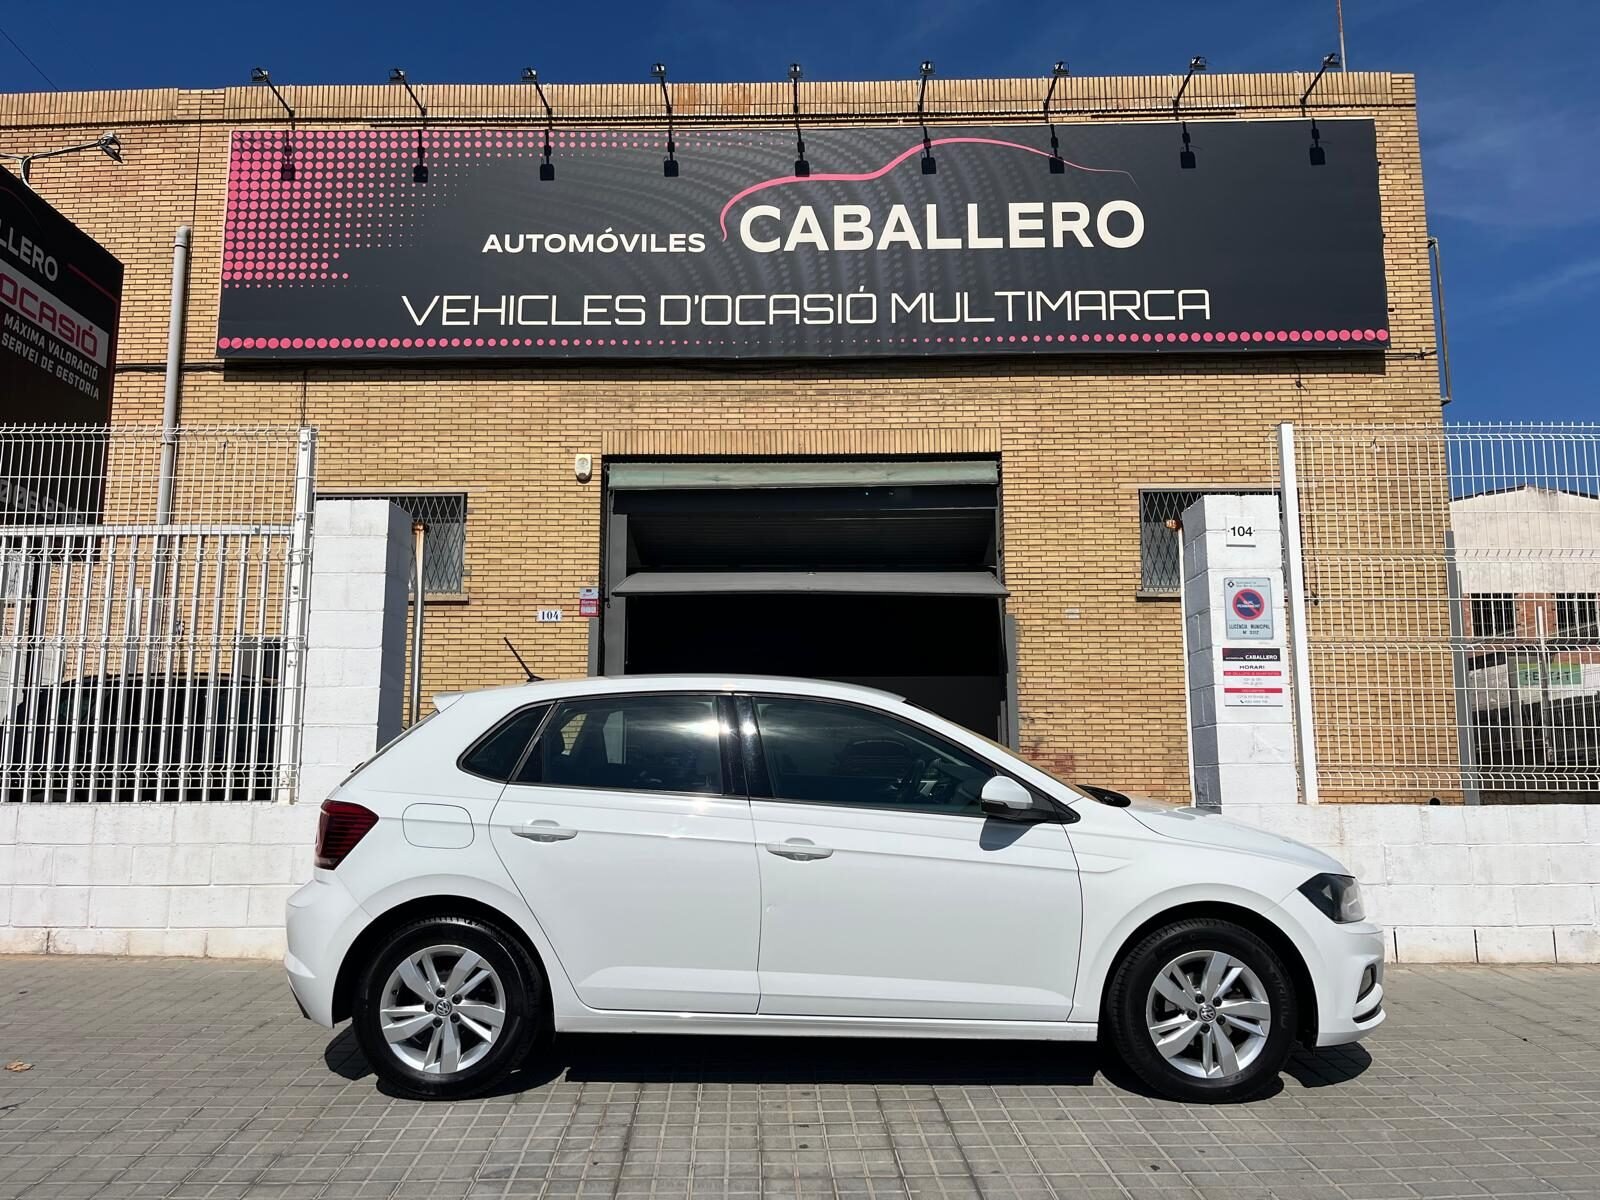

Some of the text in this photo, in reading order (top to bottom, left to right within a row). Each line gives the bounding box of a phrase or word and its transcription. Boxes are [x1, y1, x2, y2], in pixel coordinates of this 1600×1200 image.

[481, 199, 1145, 253] AUTOMÓVILES CABALLERO
[401, 285, 1211, 326] VEHICLES D'OCASIÓ MULTIMARCA
[1, 332, 39, 364] SERVEI
[40, 354, 55, 373] DE
[48, 340, 99, 380] VALORACIÓ
[1230, 526, 1253, 537] 104
[541, 611, 559, 620] 104
